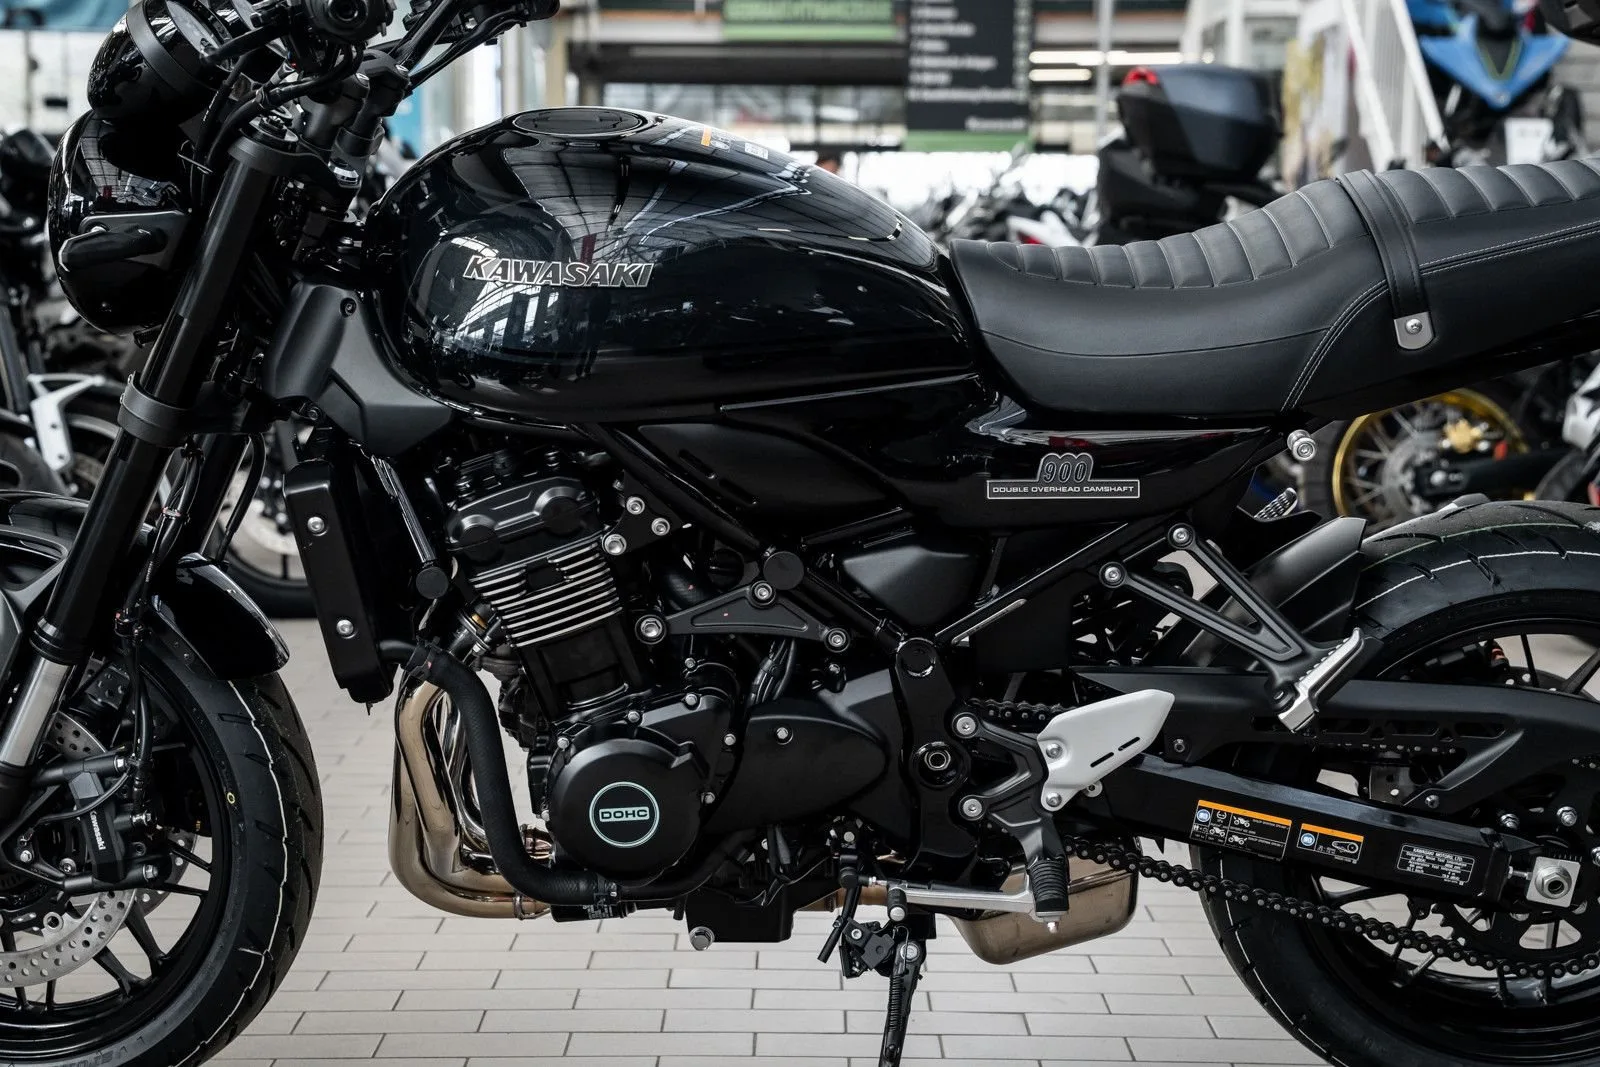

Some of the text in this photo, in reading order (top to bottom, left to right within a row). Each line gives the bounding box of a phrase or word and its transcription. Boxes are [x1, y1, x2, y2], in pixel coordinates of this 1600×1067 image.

[463, 255, 655, 288] KAWASAKI
[1043, 461, 1088, 483] 900
[1031, 485, 1081, 493] OVERHEAD
[1083, 485, 1135, 493] CAMSHAFT
[601, 809, 648, 819] DOHC
